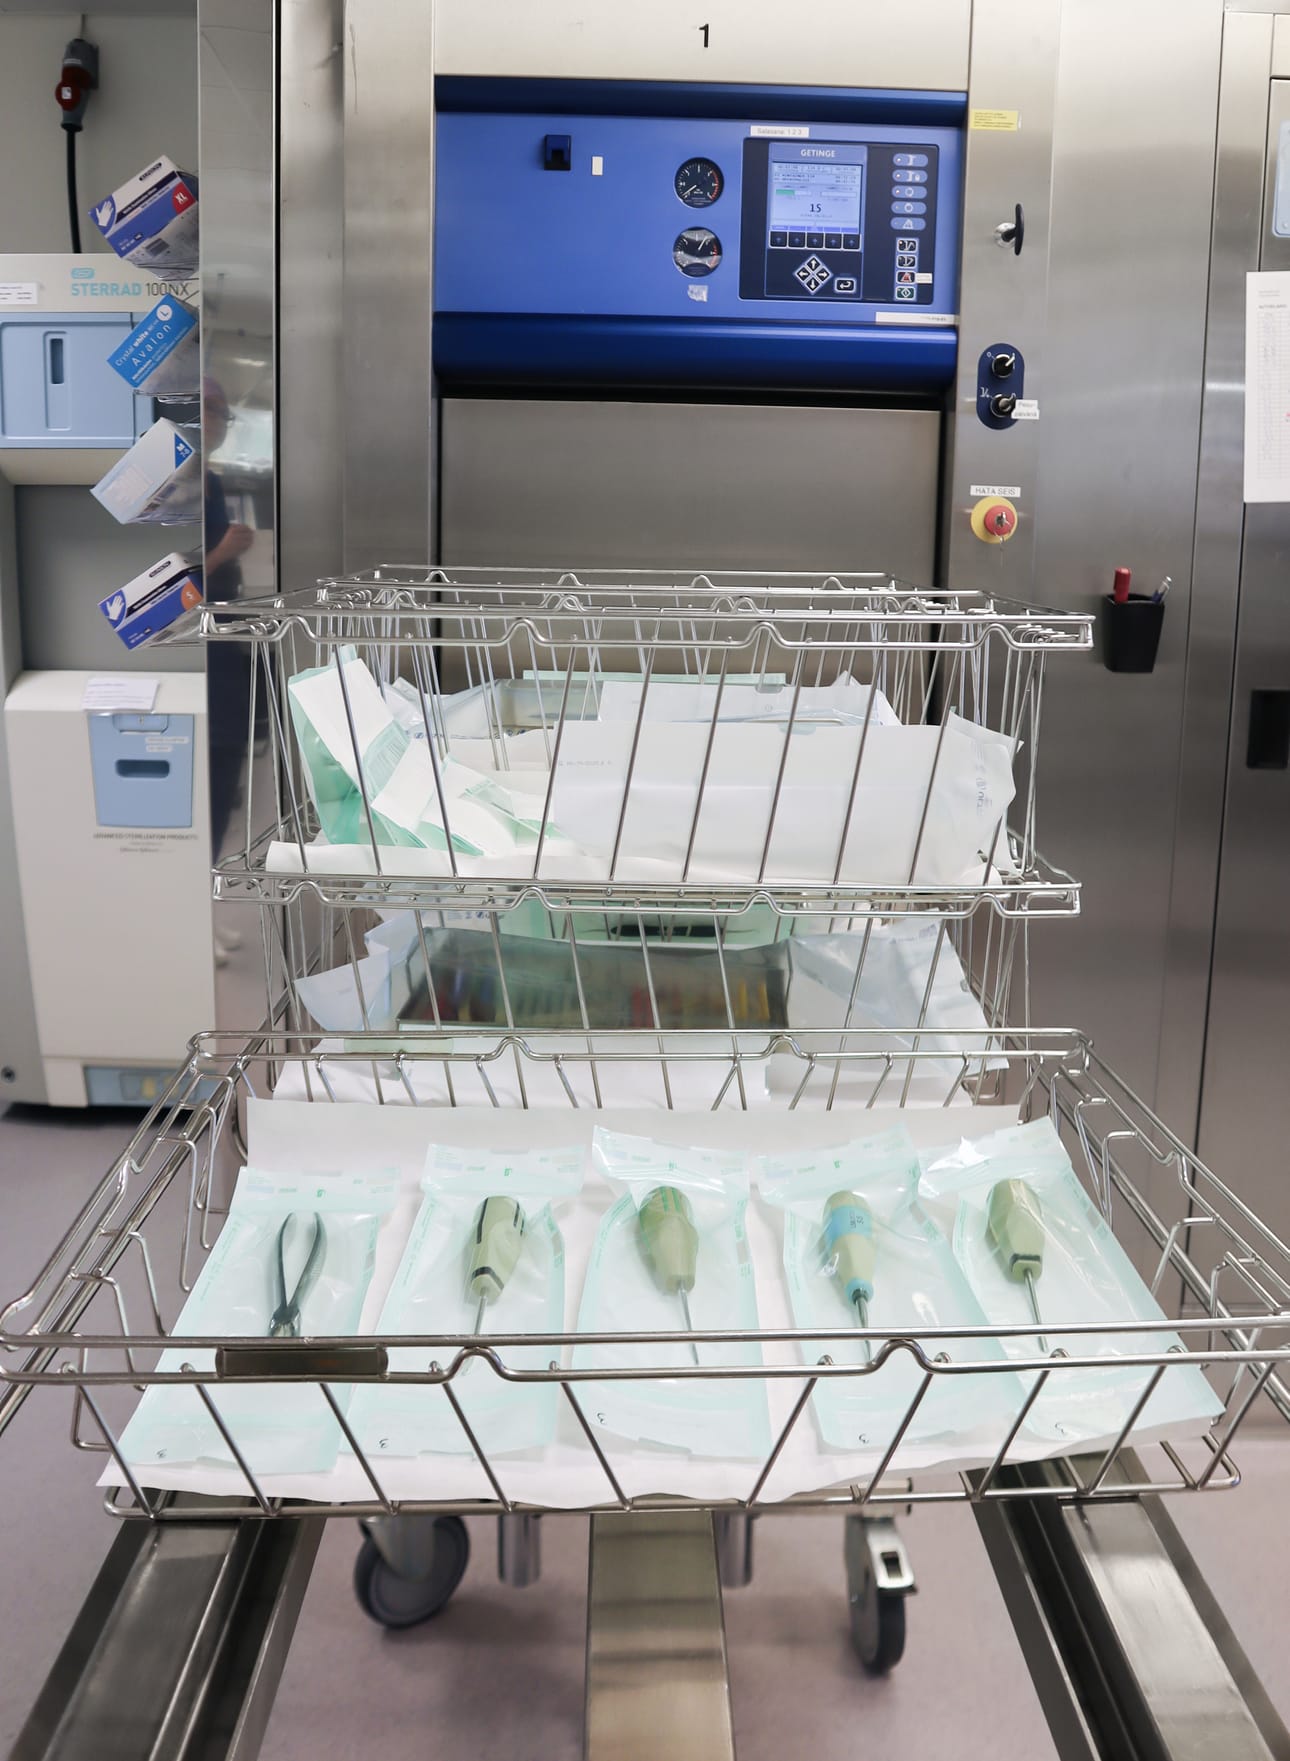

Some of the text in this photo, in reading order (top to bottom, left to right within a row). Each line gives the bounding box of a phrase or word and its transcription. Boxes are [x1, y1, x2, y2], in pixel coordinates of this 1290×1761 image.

[699, 23, 710, 48] 1
[800, 149, 836, 158] GETINGE
[175, 192, 188, 205] XL
[809, 203, 822, 213] 15
[71, 282, 190, 297] STERRAD 100NX
[130, 323, 172, 367] Avalon
